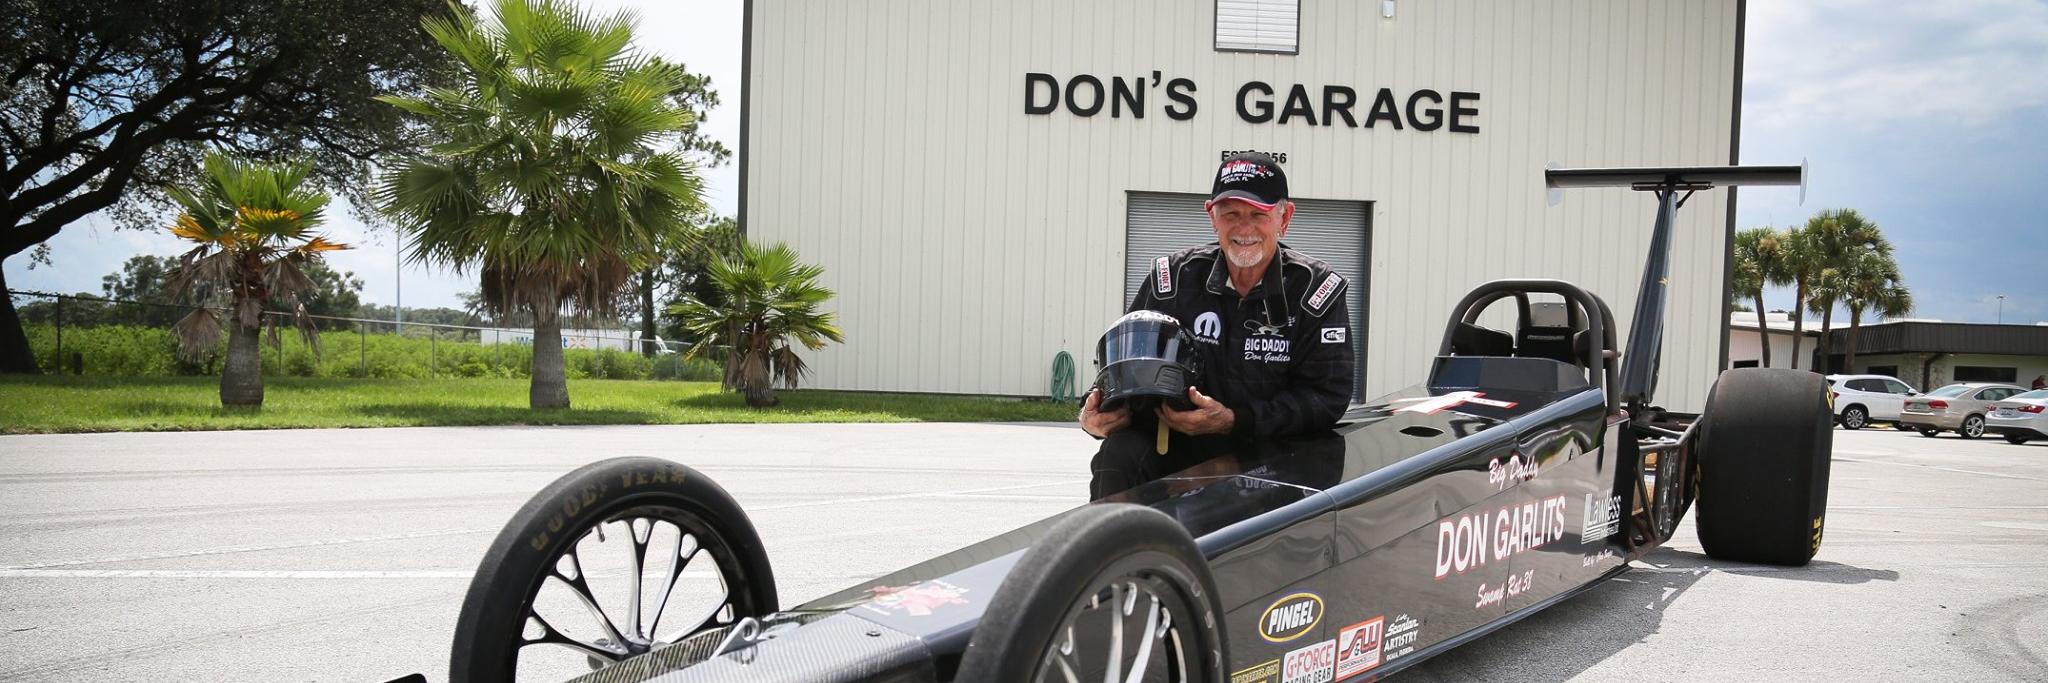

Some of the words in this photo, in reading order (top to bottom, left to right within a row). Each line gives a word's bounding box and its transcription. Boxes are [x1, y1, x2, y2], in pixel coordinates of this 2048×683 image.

[1024, 70, 1198, 121] DON'S
[1235, 80, 1481, 134] GARAGE
[1244, 338, 1260, 351] BIG
[1261, 338, 1290, 353] DADDY
[1244, 351, 1262, 360] Don
[1489, 457, 1506, 490] Big
[1435, 512, 1489, 579] DON
[1493, 494, 1567, 562] GARLITS
[1506, 574, 1522, 599] Rat
[1268, 600, 1314, 635] PINGEL
[1384, 630, 1419, 652] ARTISTRY
[1286, 644, 1334, 679] G-FORCE
[1313, 667, 1332, 683] GEAR
